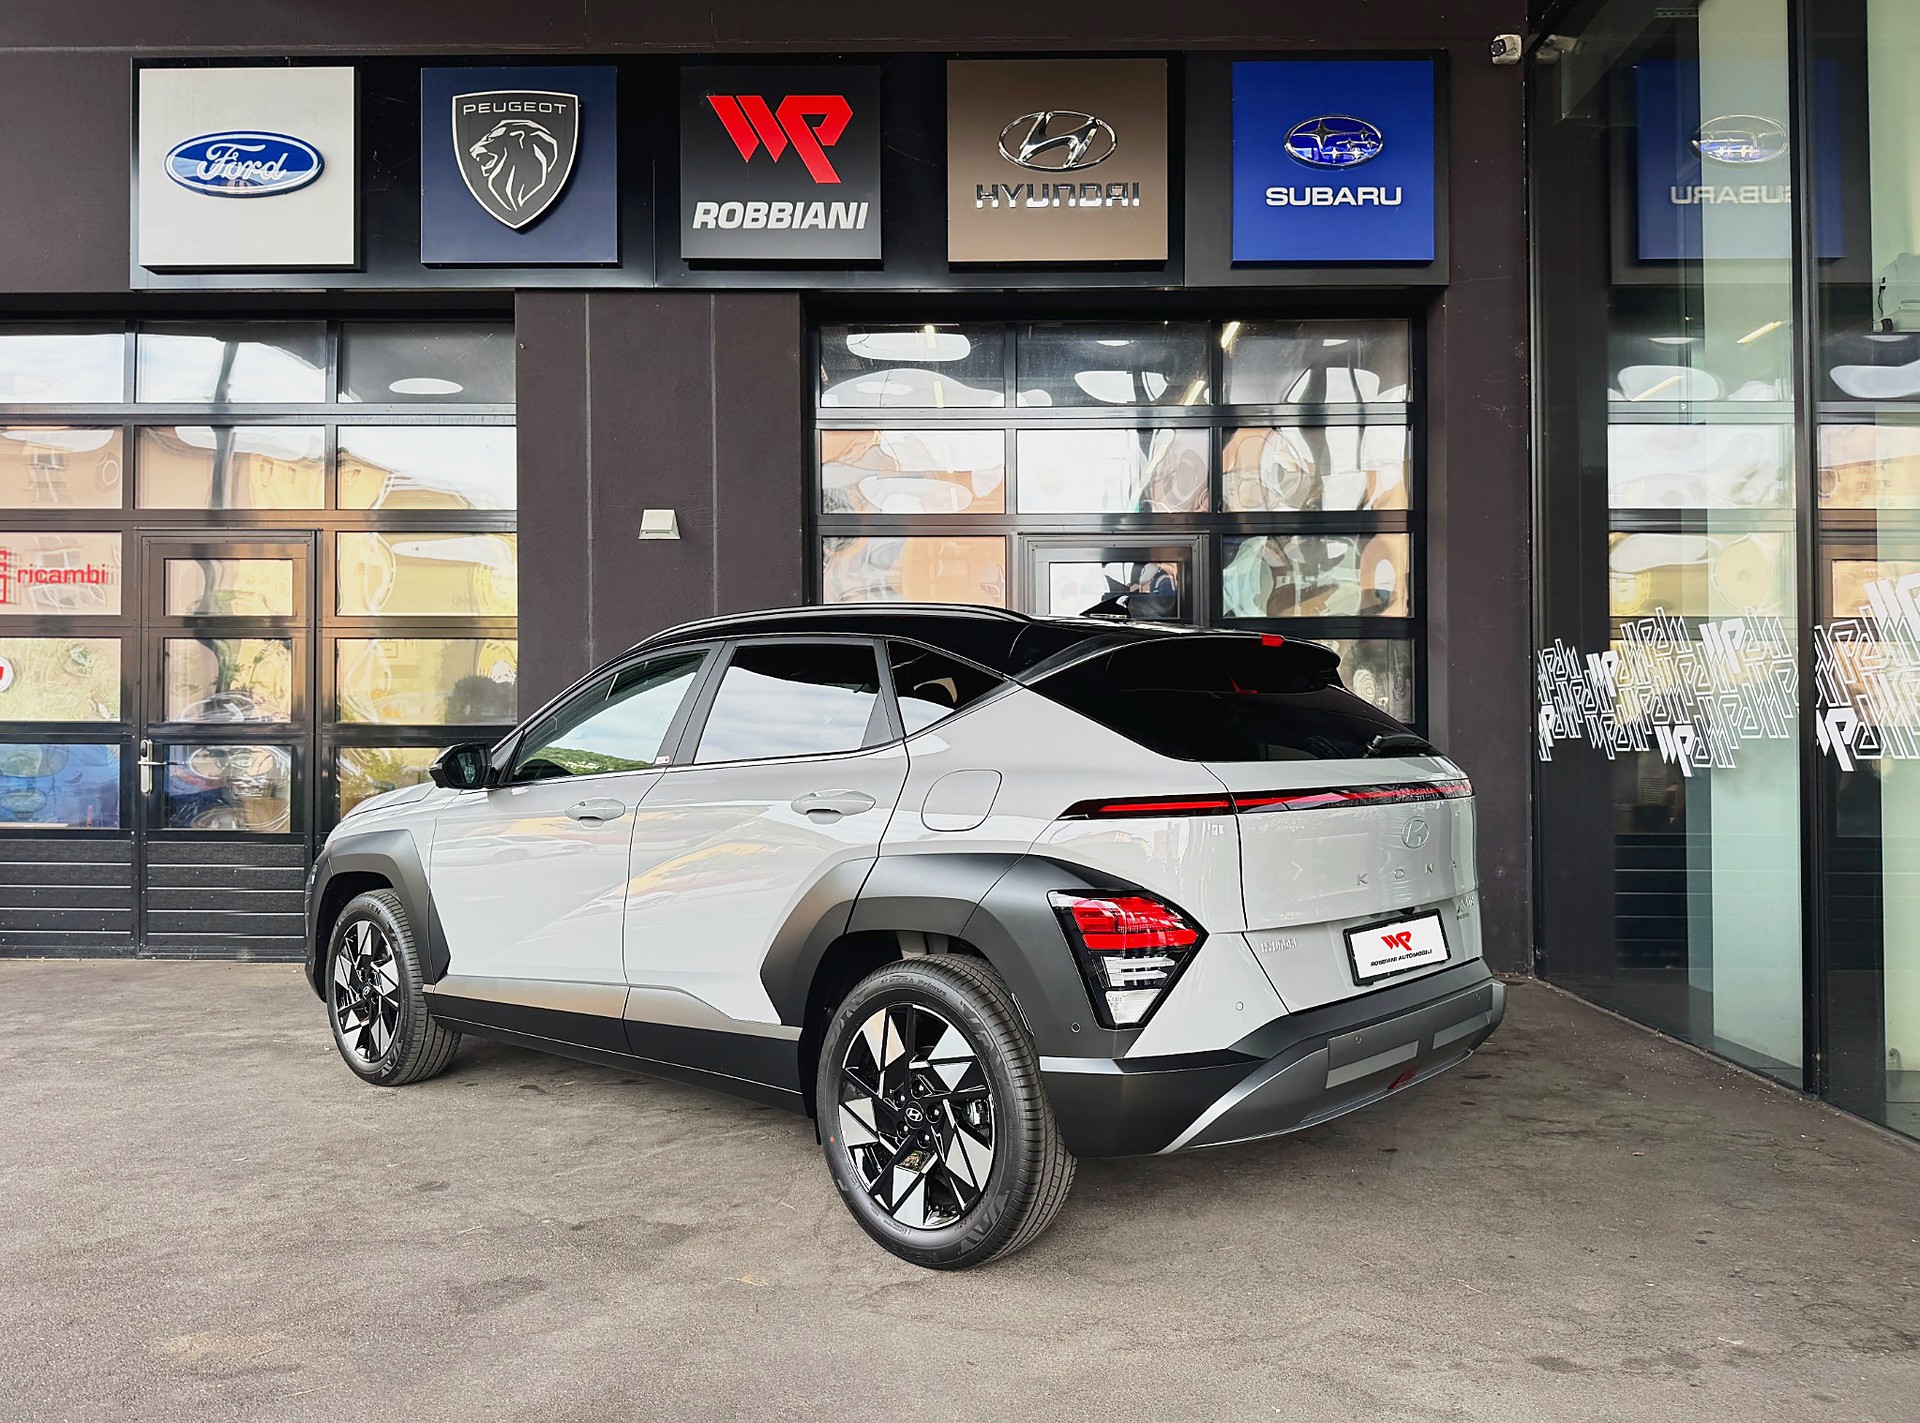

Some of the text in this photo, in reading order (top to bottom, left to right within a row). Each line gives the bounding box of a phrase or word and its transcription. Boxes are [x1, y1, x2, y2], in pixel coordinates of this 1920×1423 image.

[463, 103, 567, 116] PEUGEOT
[196, 143, 288, 181] Ford
[975, 182, 1140, 208] HYUNDAI
[1265, 187, 1402, 206] SUBARU
[692, 202, 870, 229] ROBBIANI
[17, 563, 106, 584] ricambi
[1357, 860, 1458, 886] KONA
